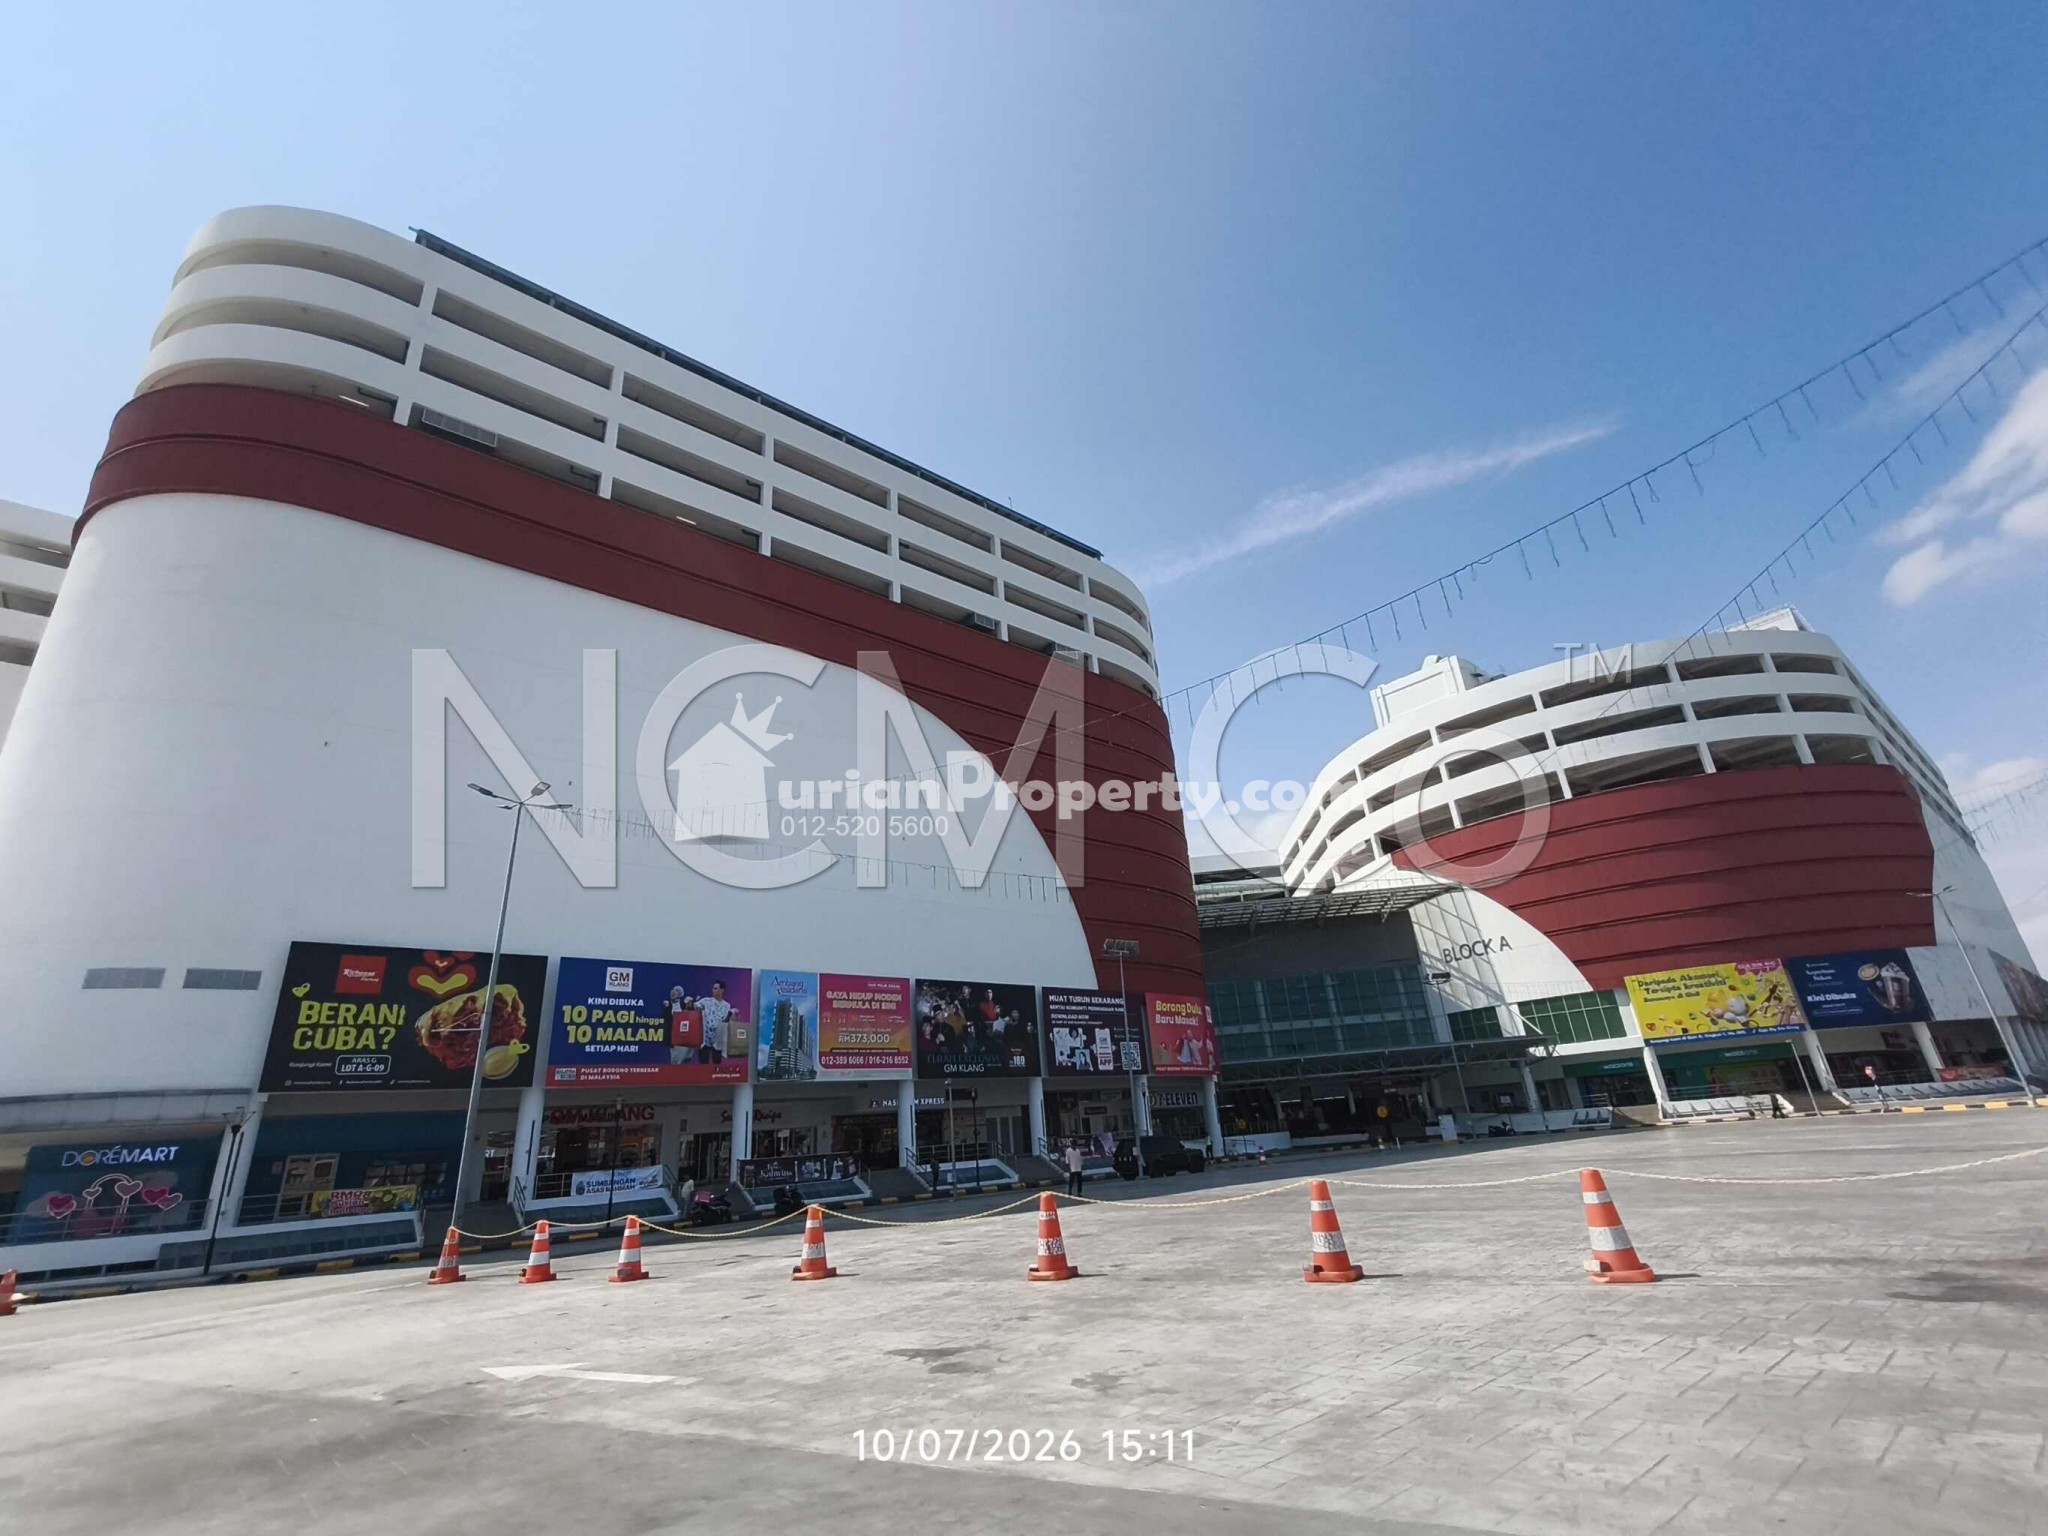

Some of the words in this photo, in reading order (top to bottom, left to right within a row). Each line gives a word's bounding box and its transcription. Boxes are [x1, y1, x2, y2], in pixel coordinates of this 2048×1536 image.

[1442, 938, 1497, 964] BLOCK
[1499, 935, 1513, 952] A
[609, 971, 630, 982] GM
[587, 997, 608, 1006] KINI
[608, 998, 644, 1006] DIBUKA
[1155, 1000, 1187, 1015] Borong
[297, 1001, 406, 1026] BERANI
[562, 1005, 588, 1024] 10
[591, 1010, 635, 1024] PAGI
[1155, 1013, 1175, 1024] Baru
[293, 1027, 397, 1051] CUBA?
[566, 1025, 592, 1043] 10
[596, 1028, 664, 1042] MALAM
[584, 1045, 616, 1053] SETIAP
[617, 1045, 639, 1053] HARI
[943, 1063, 958, 1073] GM
[958, 1063, 985, 1072] KLANG
[1099, 1058, 1112, 1066] APP
